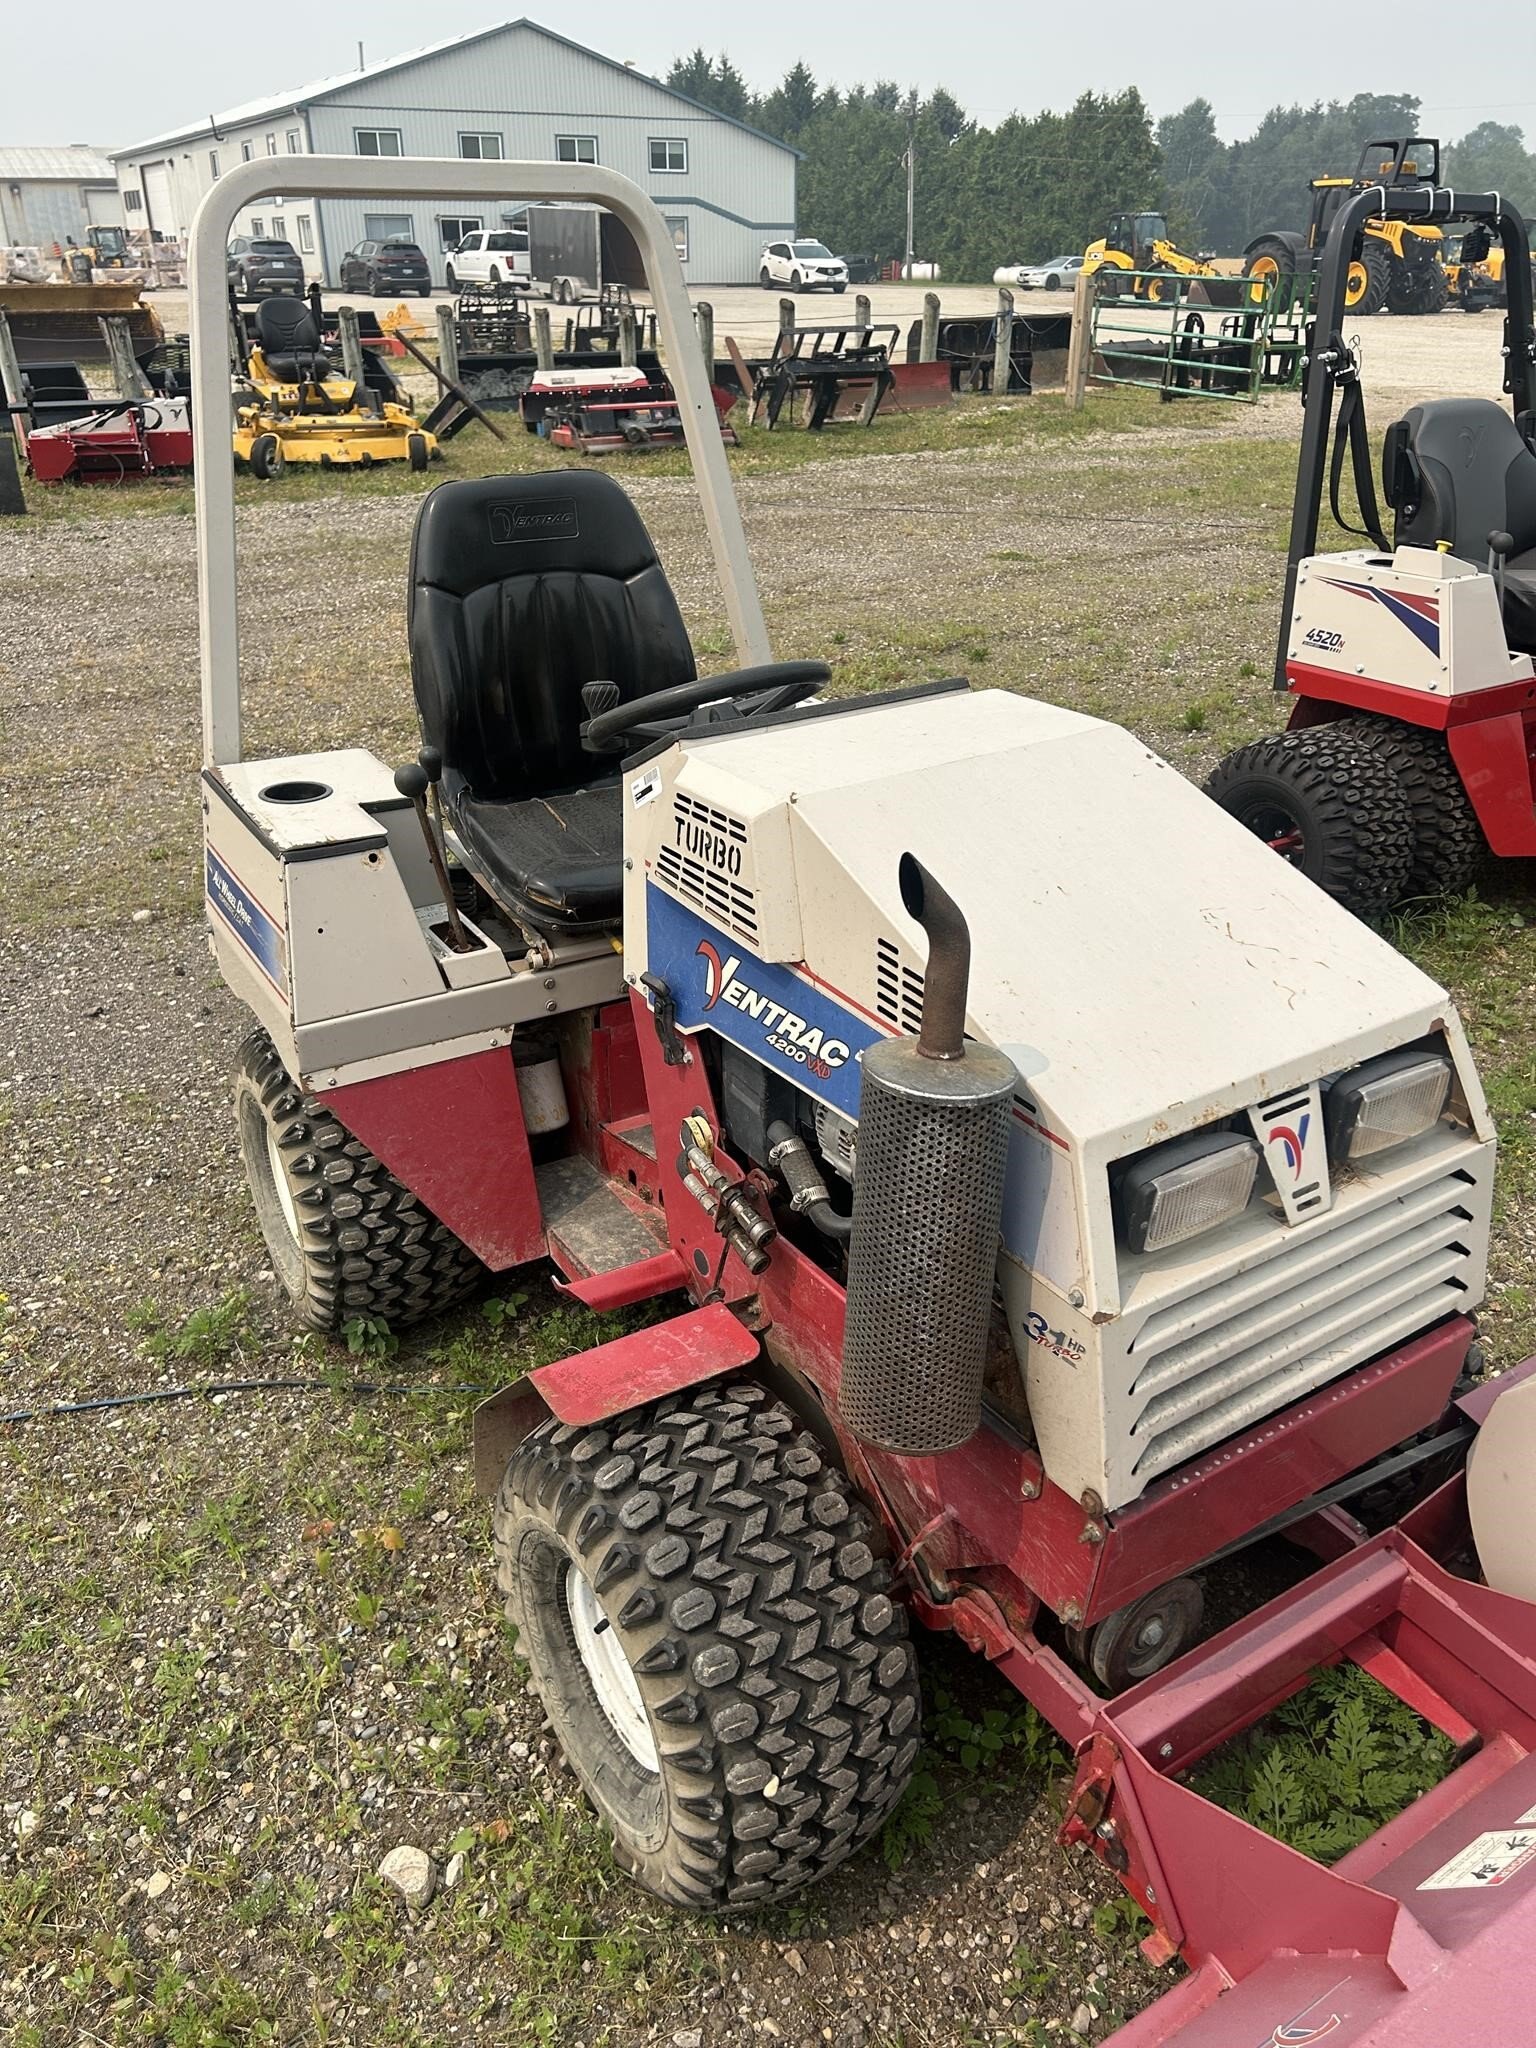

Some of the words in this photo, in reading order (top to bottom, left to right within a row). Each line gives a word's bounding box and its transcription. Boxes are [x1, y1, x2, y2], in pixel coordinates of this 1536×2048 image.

[493, 504, 575, 537] VENTRAC
[674, 815, 742, 877] TURBO
[696, 939, 850, 1069] VENTRAC
[1037, 1335, 1081, 1360] TURBO
[1067, 1337, 1087, 1354] HP
